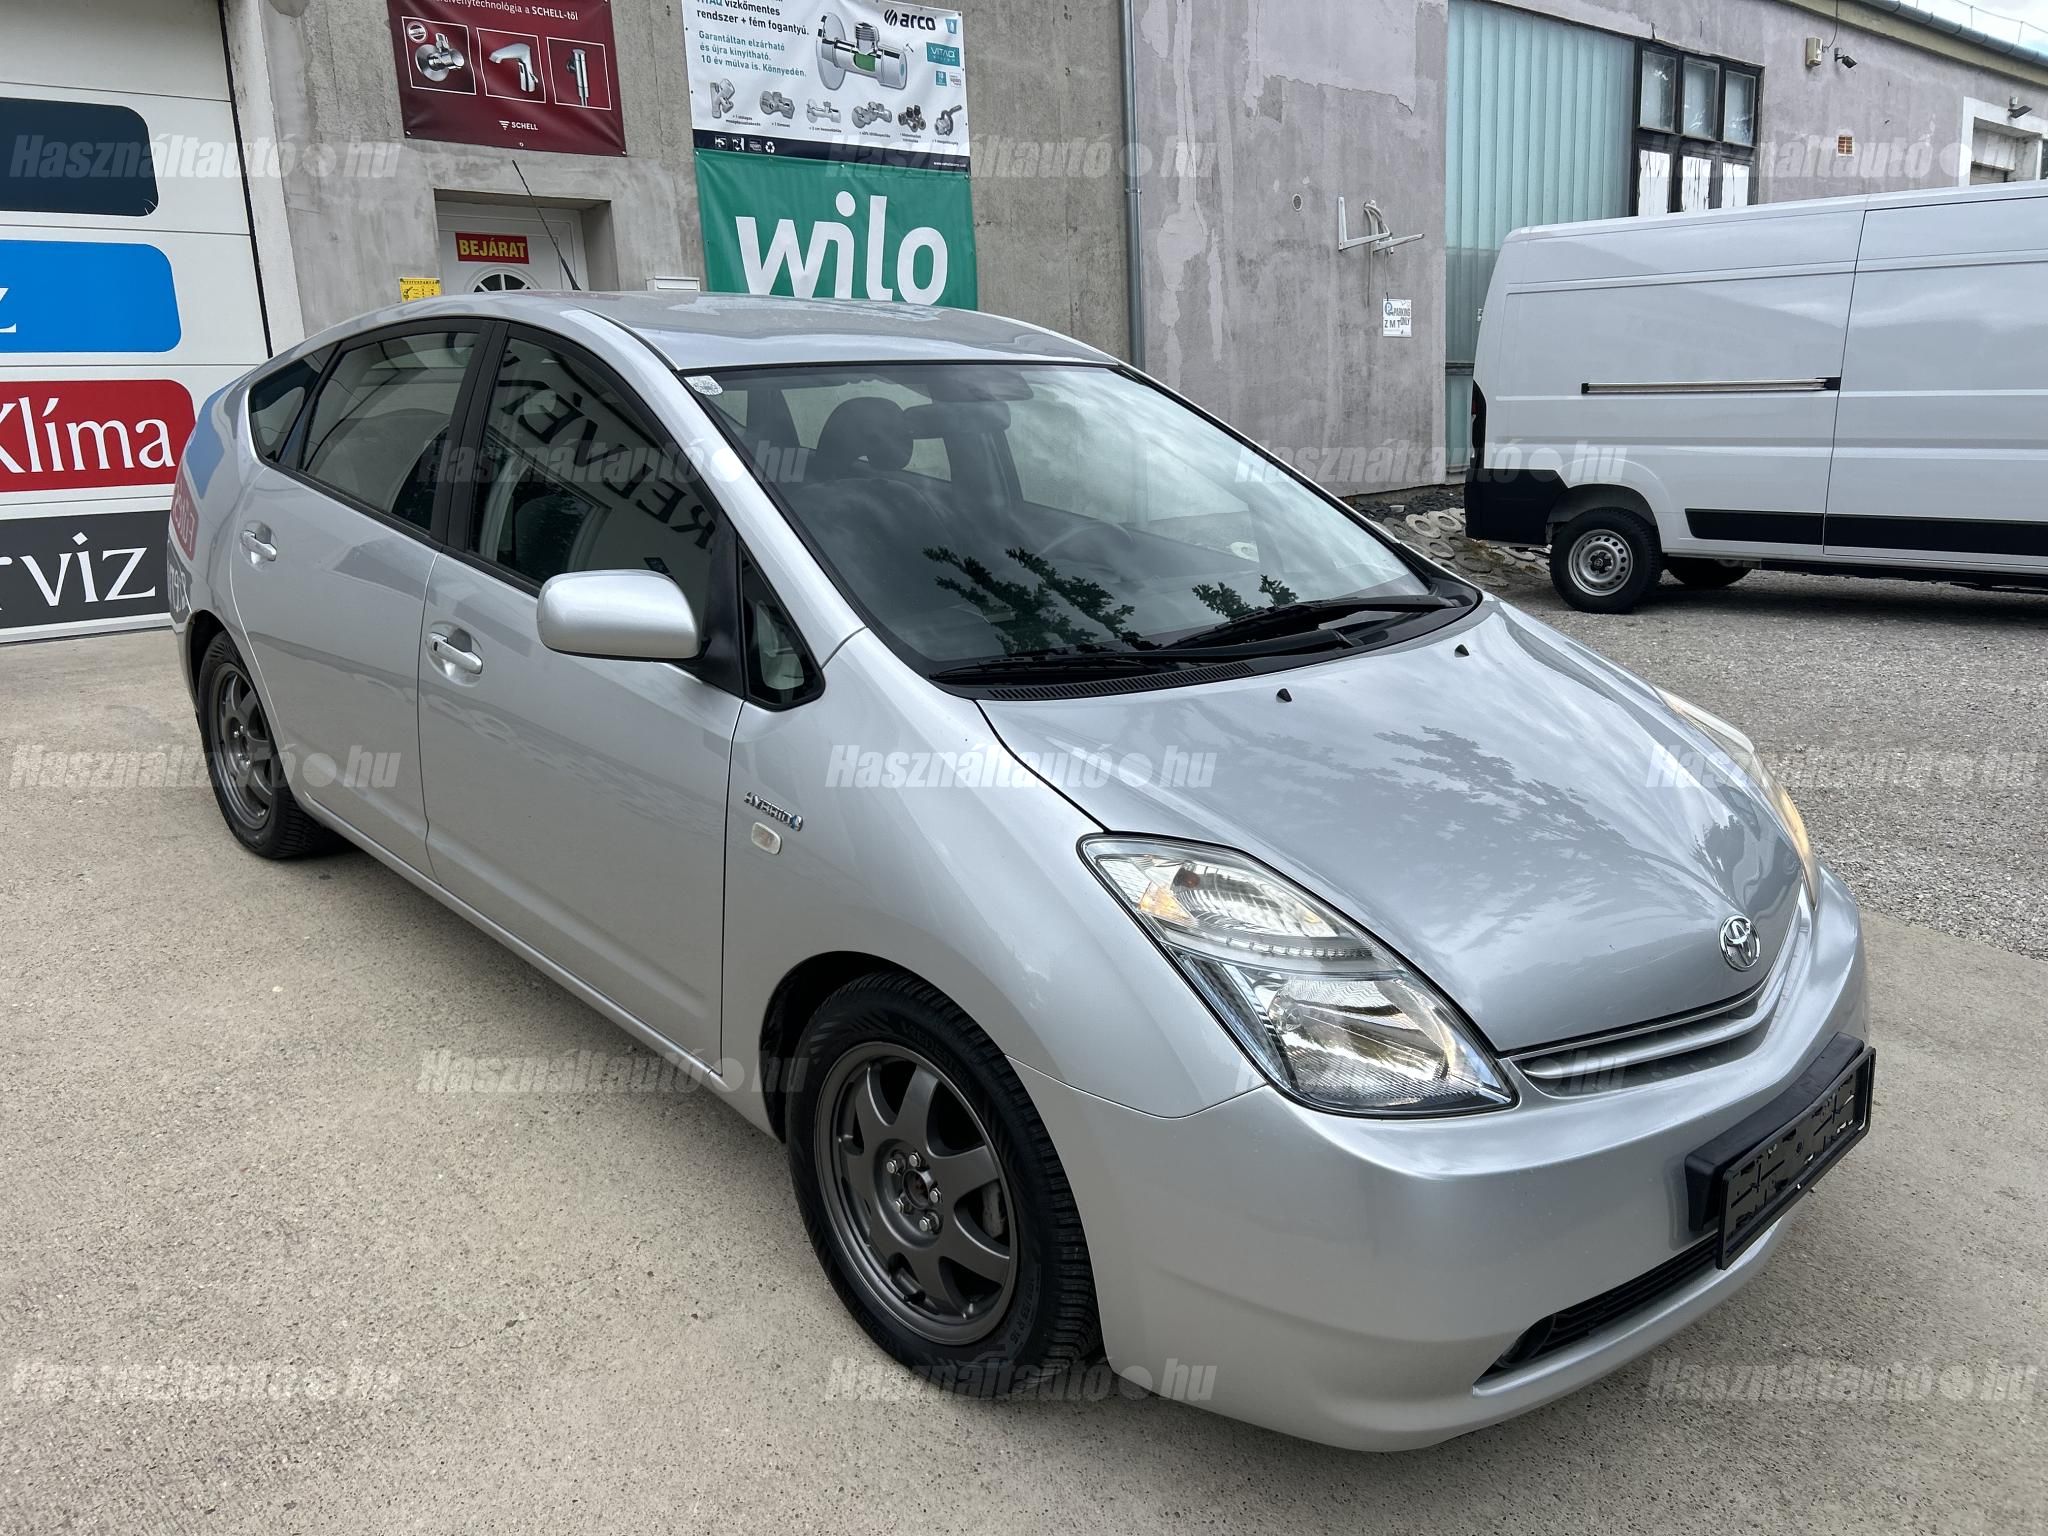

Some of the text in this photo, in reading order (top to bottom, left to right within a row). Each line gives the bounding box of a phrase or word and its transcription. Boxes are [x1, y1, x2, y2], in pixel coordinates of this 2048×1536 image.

[697, 9, 738, 24] rendszer
[749, 16, 766, 29] fém
[768, 20, 810, 36] fogantyú.
[900, 13, 936, 31] arco
[699, 30, 785, 51] Garantáltan elzárható
[700, 42, 710, 52] és
[713, 45, 728, 55] újra
[701, 54, 711, 64] 10
[714, 56, 723, 65] év
[725, 59, 749, 70] múlva
[511, 121, 539, 131] SCHELL
[459, 237, 526, 258] BEJÁRAT
[735, 190, 948, 305] wilo
